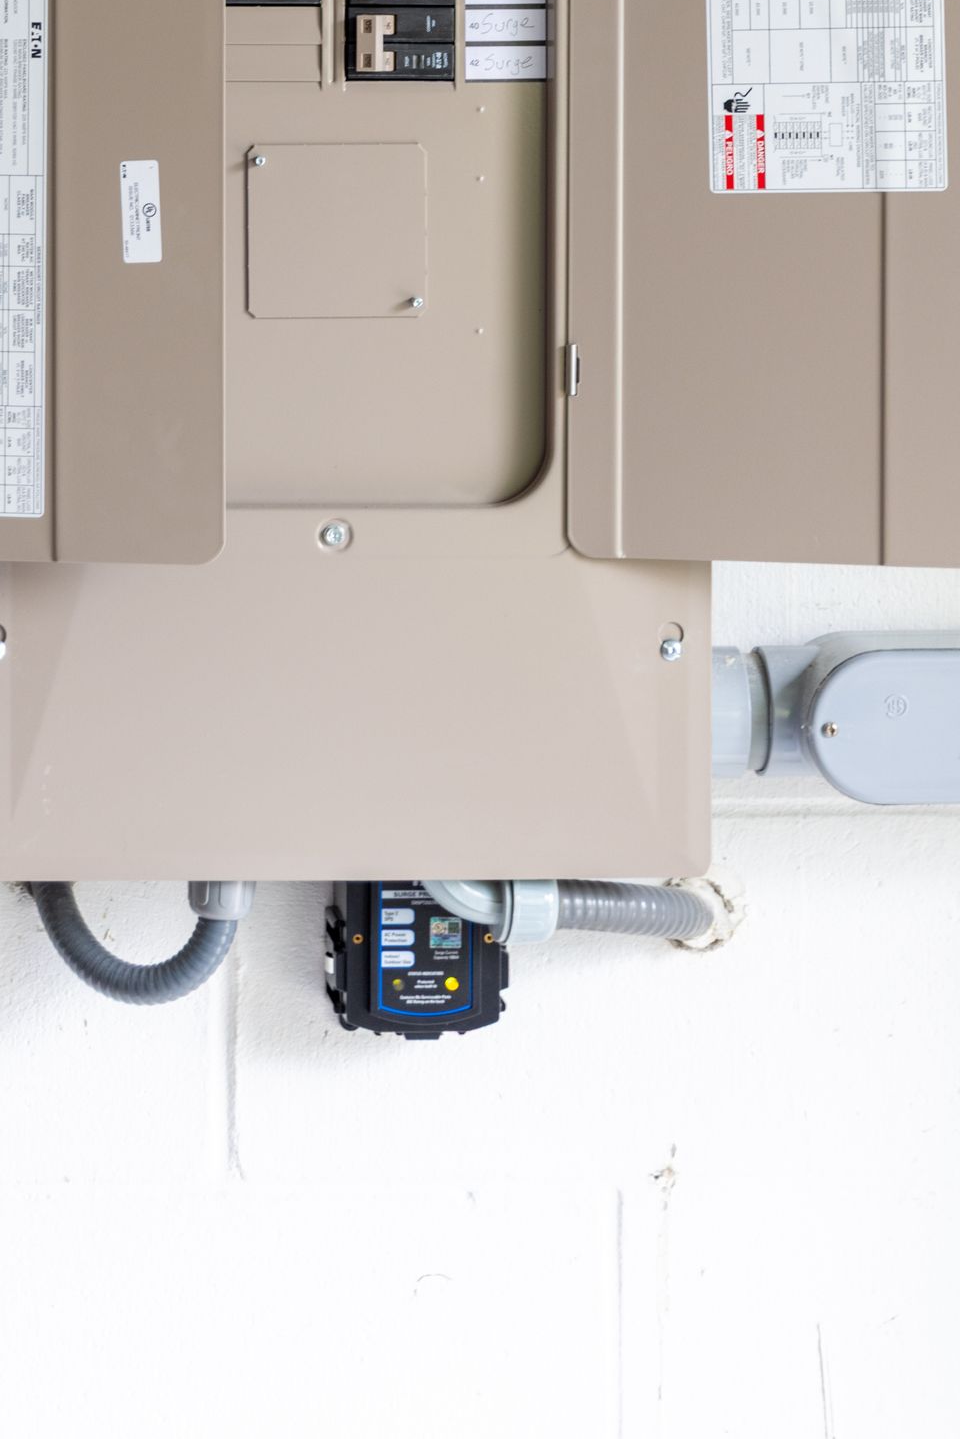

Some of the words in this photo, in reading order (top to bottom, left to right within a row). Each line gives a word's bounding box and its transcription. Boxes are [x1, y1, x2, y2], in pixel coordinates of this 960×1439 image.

[469, 21, 480, 30] 40
[480, 12, 535, 37] Surge
[469, 59, 480, 67] 42
[484, 53, 534, 76] Surge
[725, 141, 734, 176] PELIGRO
[756, 140, 765, 174] DANGER
